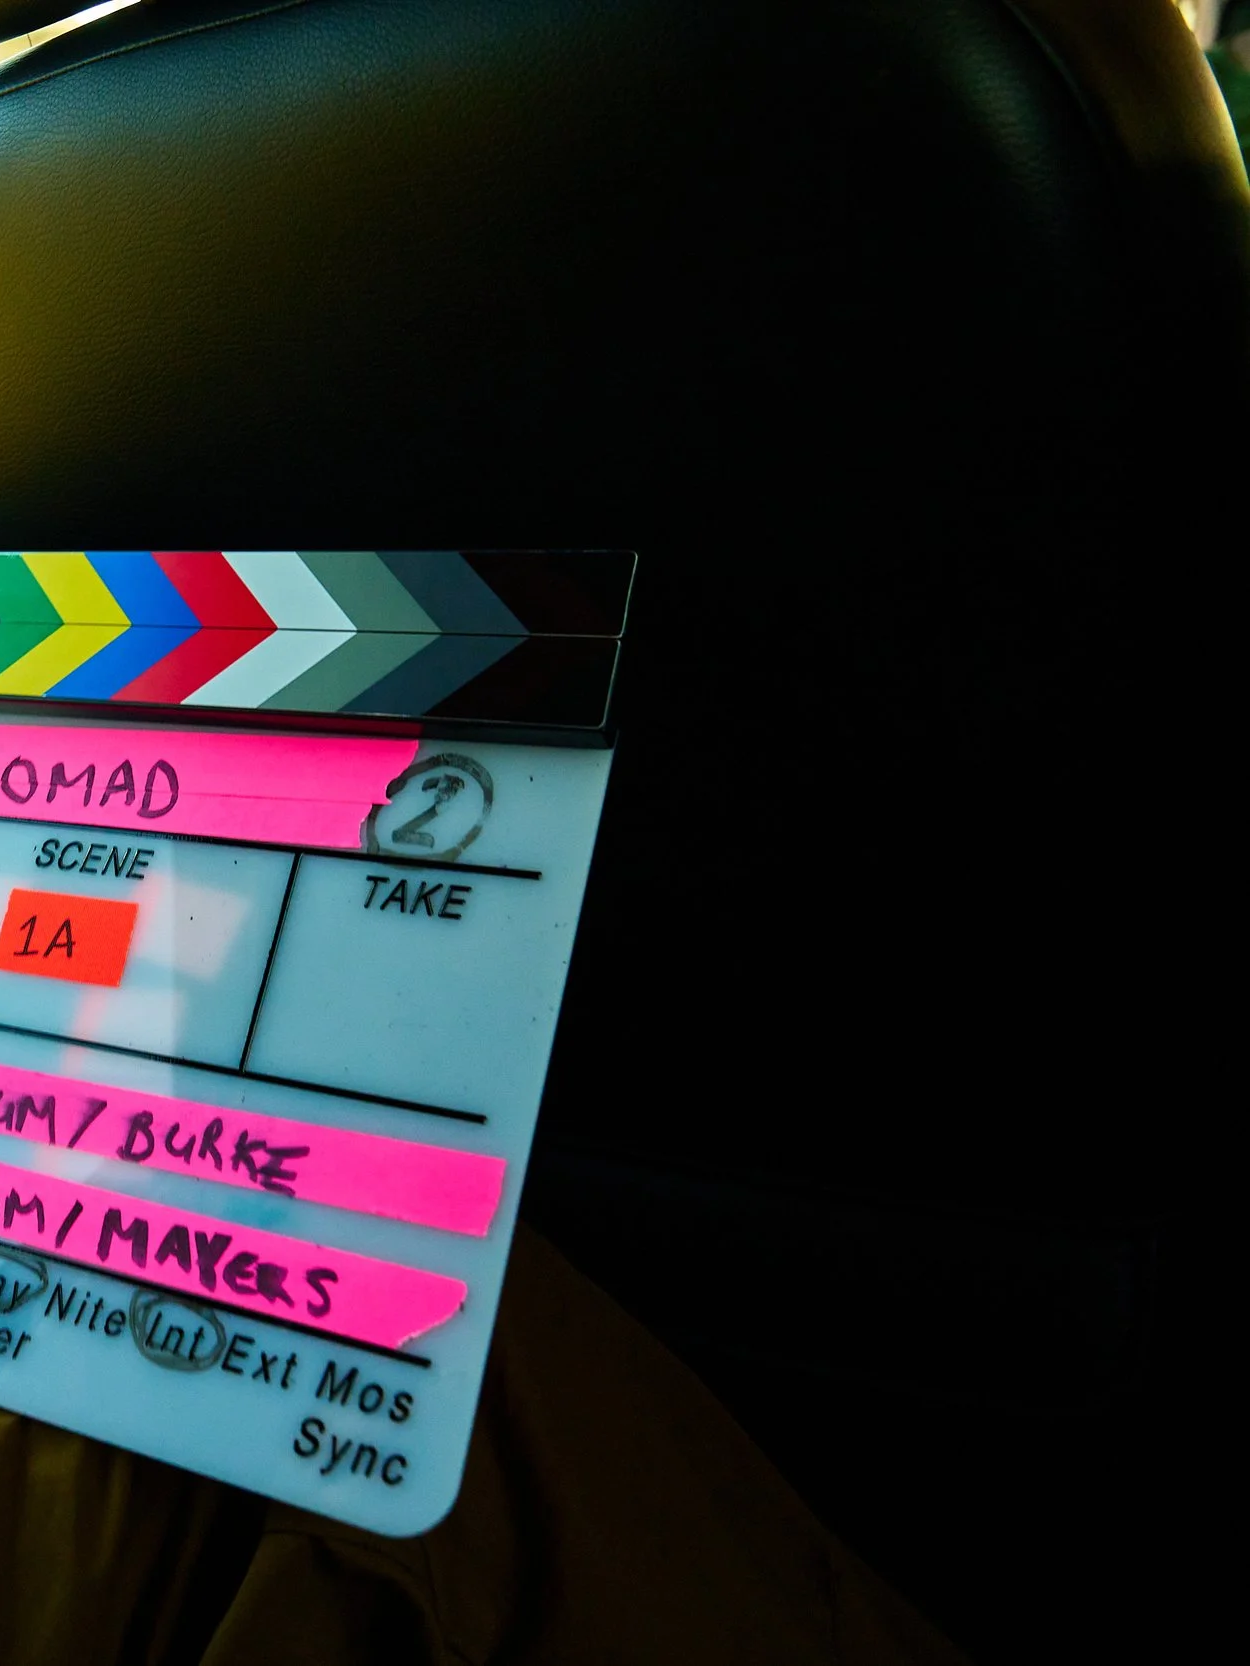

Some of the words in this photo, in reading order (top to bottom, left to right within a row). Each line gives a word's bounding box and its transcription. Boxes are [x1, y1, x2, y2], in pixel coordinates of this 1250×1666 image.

[34, 838, 155, 881] SCENE
[364, 876, 472, 920] TAKE
[13, 914, 76, 959] 1A
[44, 1281, 126, 1337] Nite
[145, 1310, 205, 1361] Int
[221, 1334, 298, 1390] Ext
[315, 1360, 415, 1424] Mos
[292, 1416, 409, 1486] Sync
